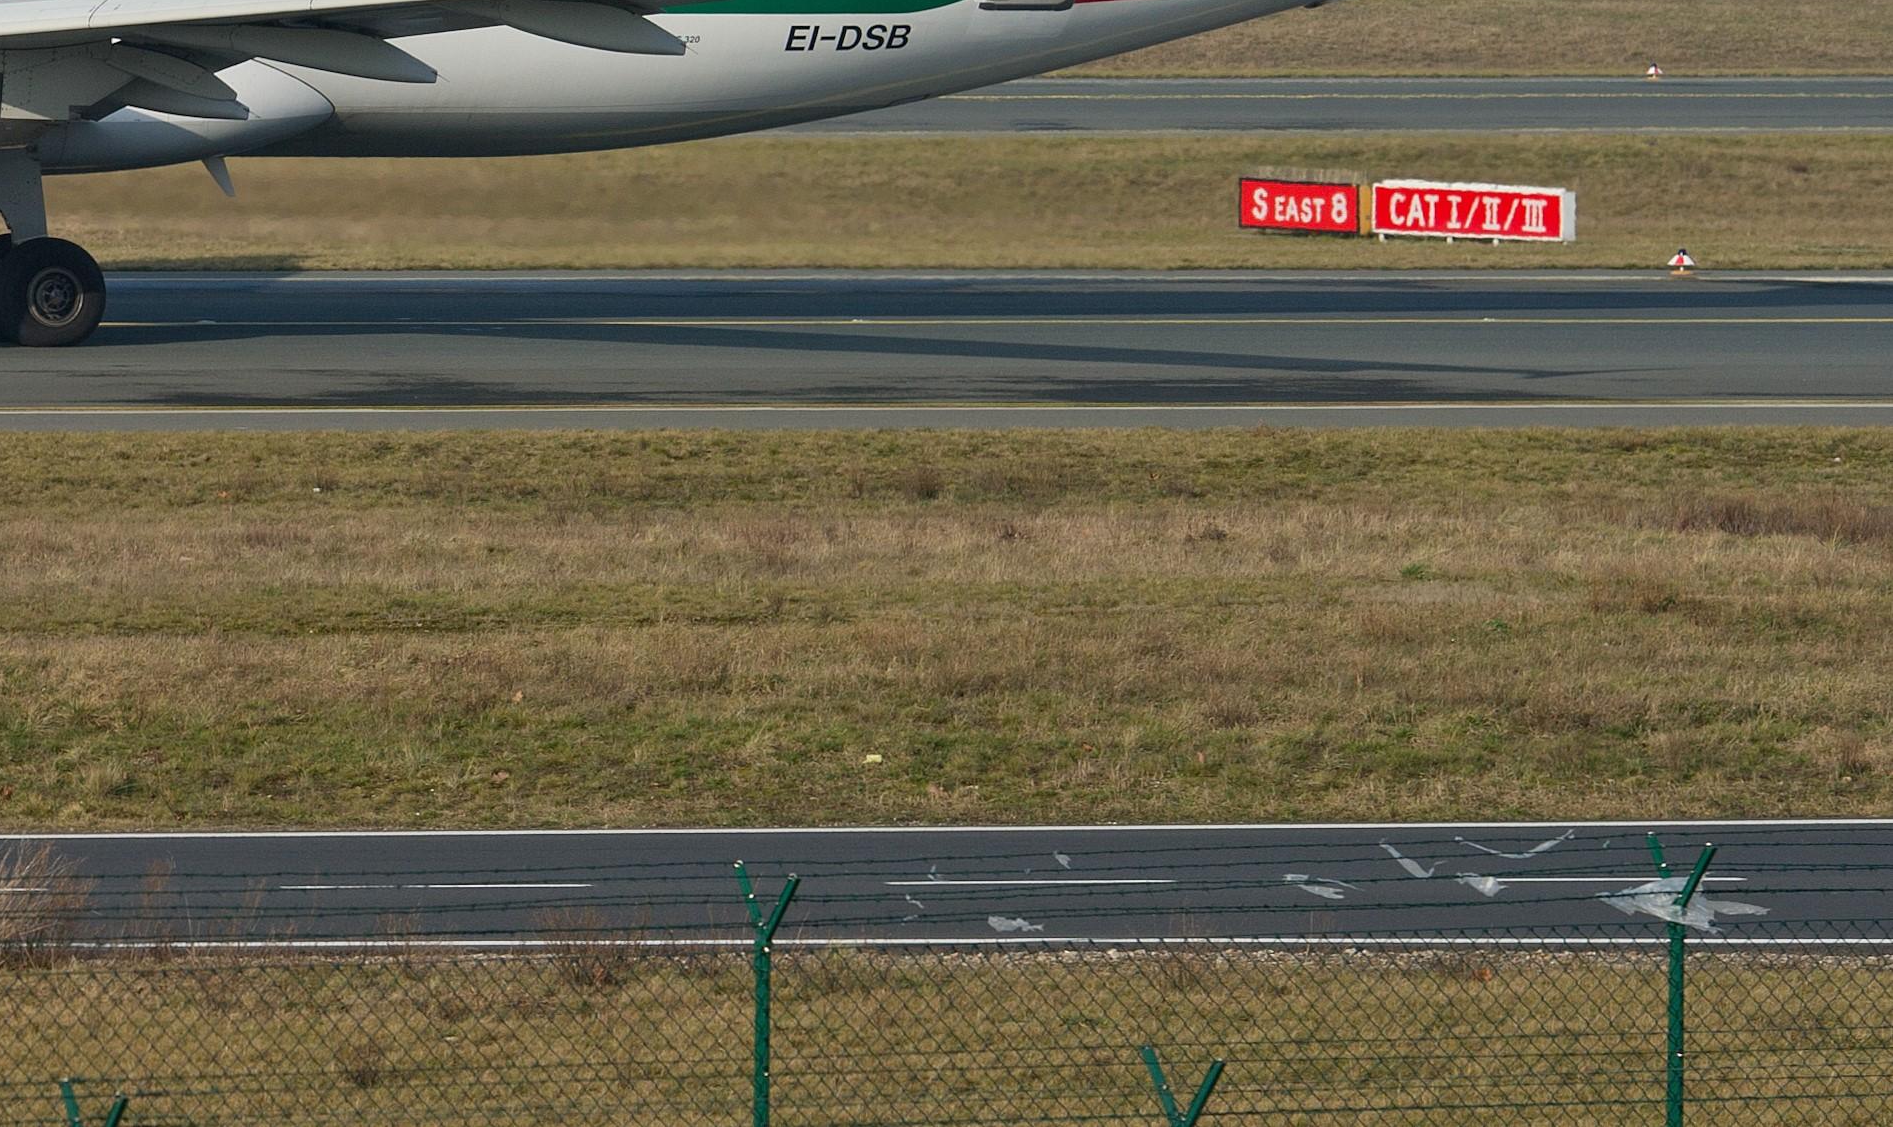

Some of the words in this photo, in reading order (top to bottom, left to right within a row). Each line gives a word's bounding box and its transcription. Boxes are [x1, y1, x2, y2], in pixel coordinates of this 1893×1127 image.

[784, 24, 912, 51] EI-DSB
[1252, 187, 1268, 221] S
[1274, 195, 1325, 223] EAST
[1331, 192, 1348, 225] 8
[1389, 192, 1436, 228] CAT
[1445, 194, 1548, 233] I/II/III
